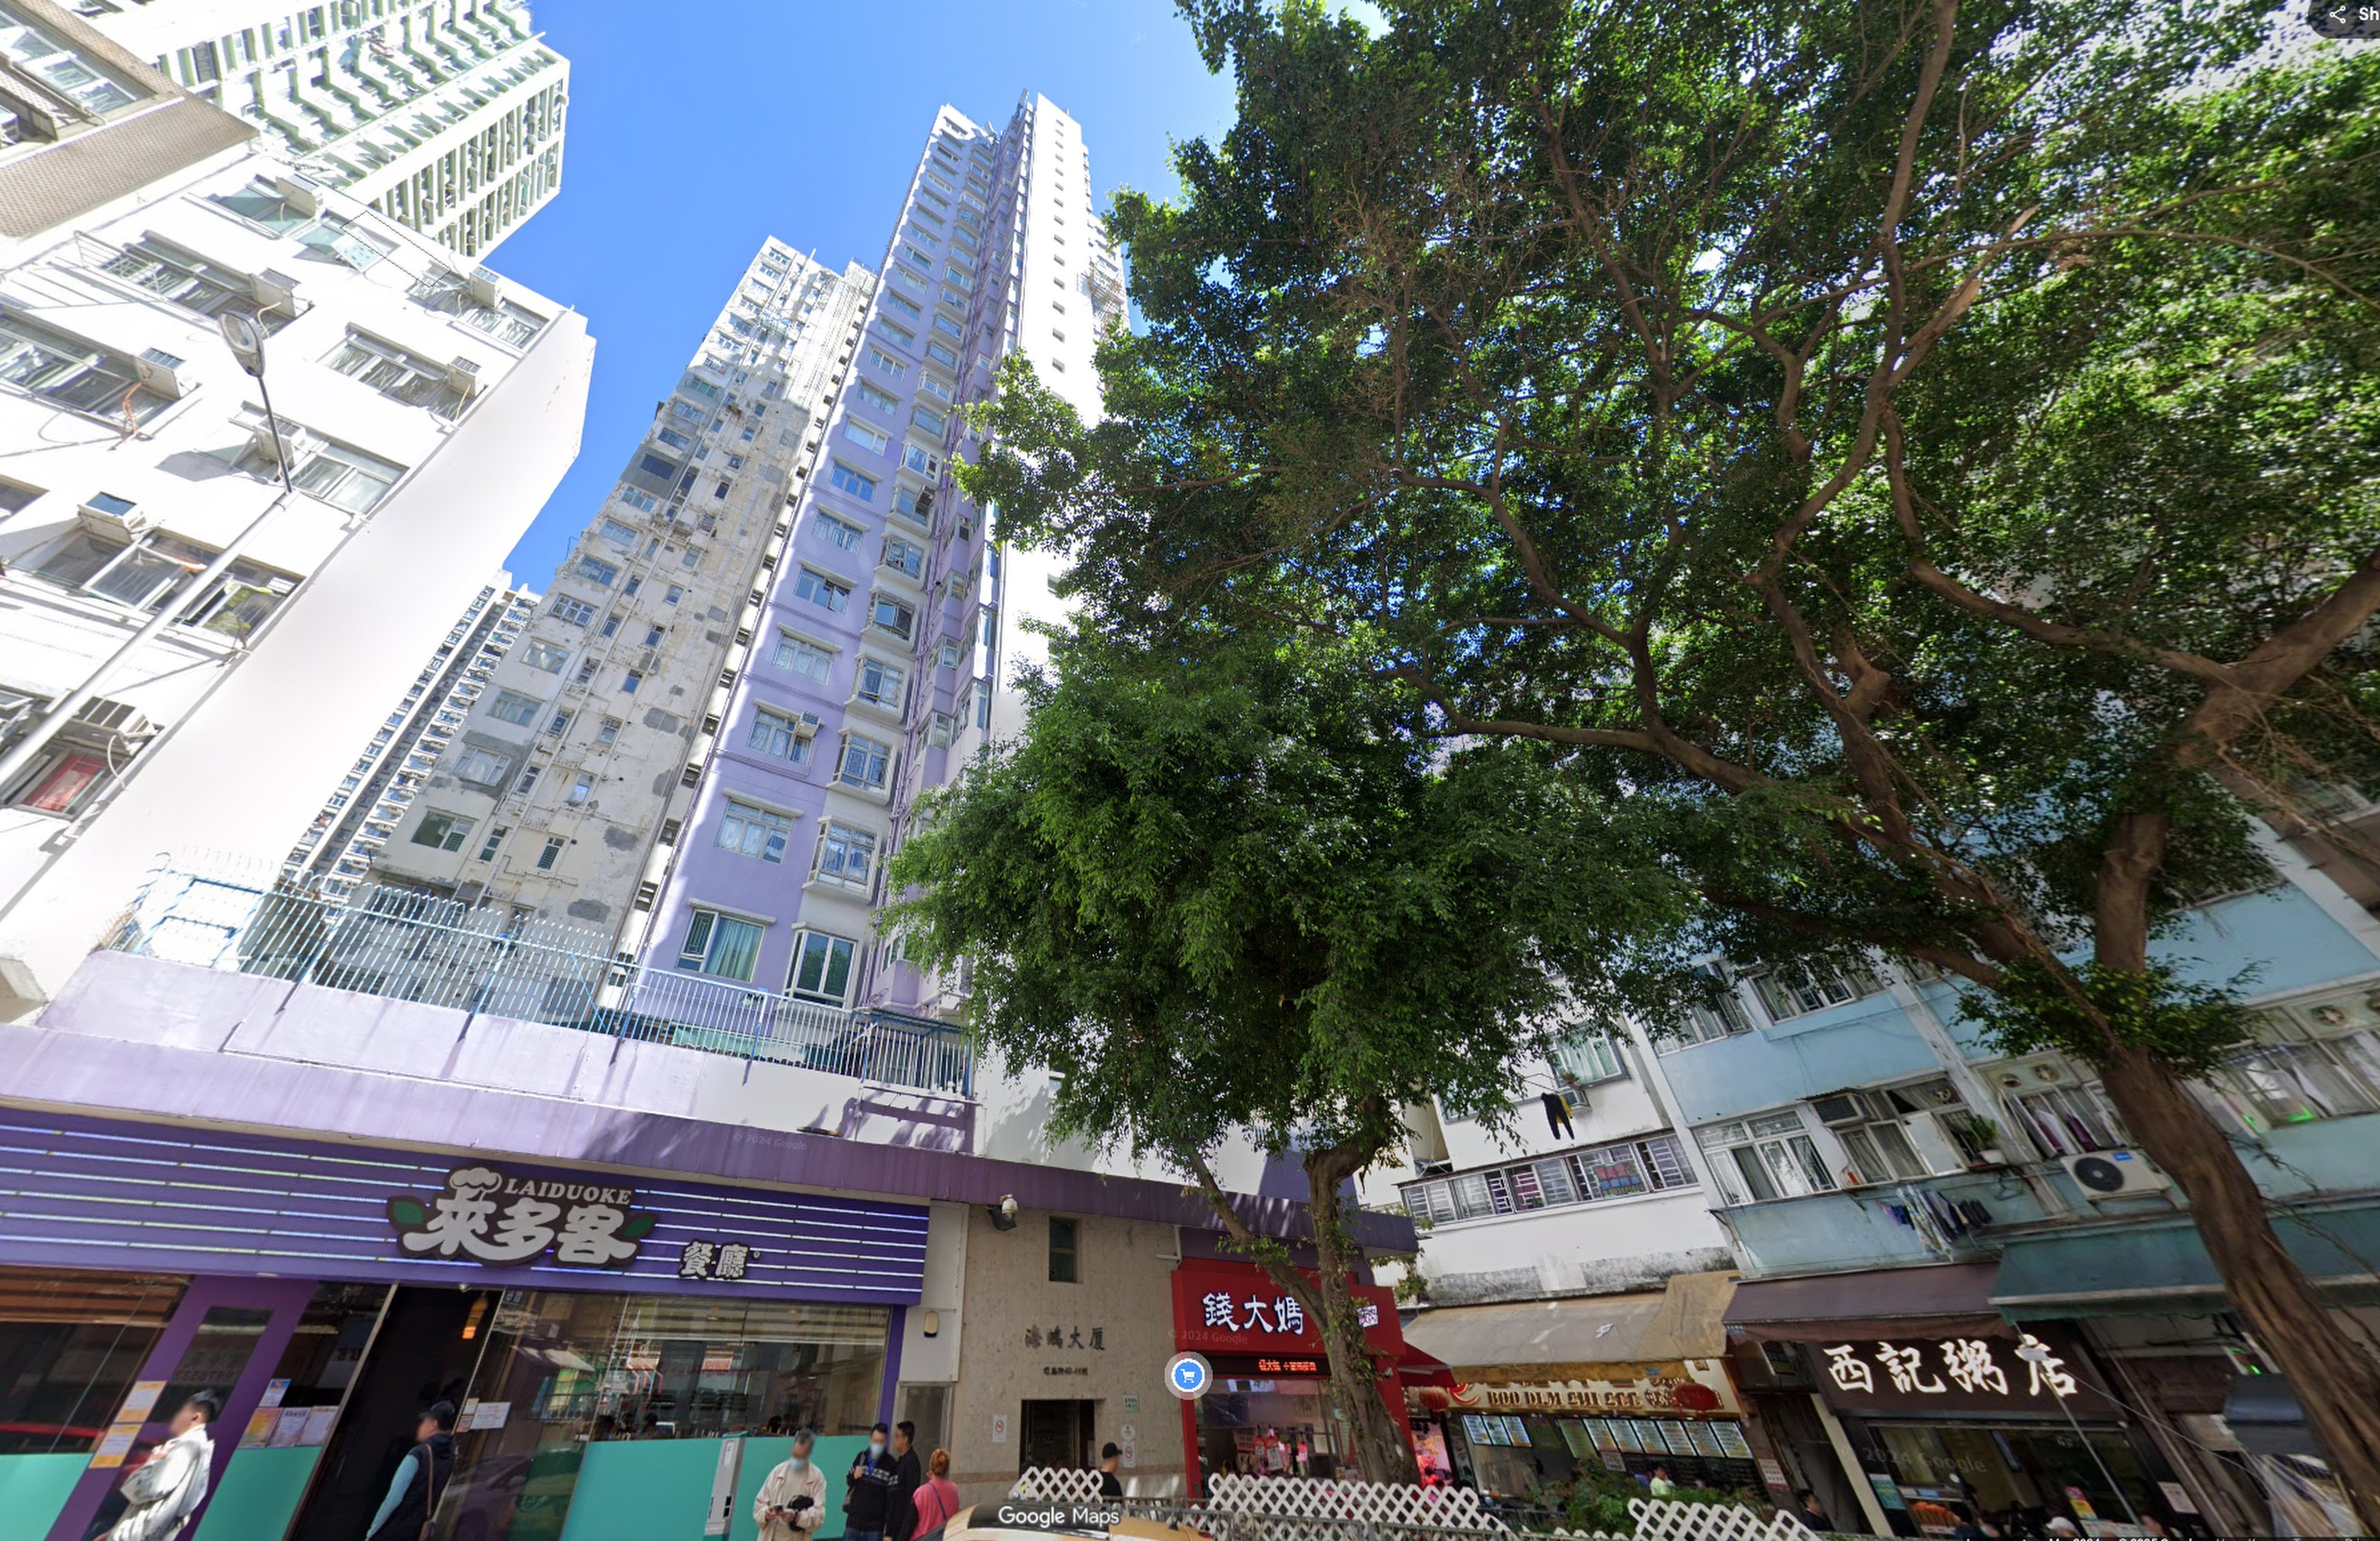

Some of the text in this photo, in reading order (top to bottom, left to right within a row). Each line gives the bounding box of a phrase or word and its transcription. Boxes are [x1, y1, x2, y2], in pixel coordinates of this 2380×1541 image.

[504, 1178, 632, 1205] LAIDUOKE
[681, 1241, 749, 1278] 餐廳
[1202, 1292, 1304, 1335] 錢大媽
[1824, 1334, 2078, 1397] 西記粥店
[1487, 1391, 1522, 1406] BOO
